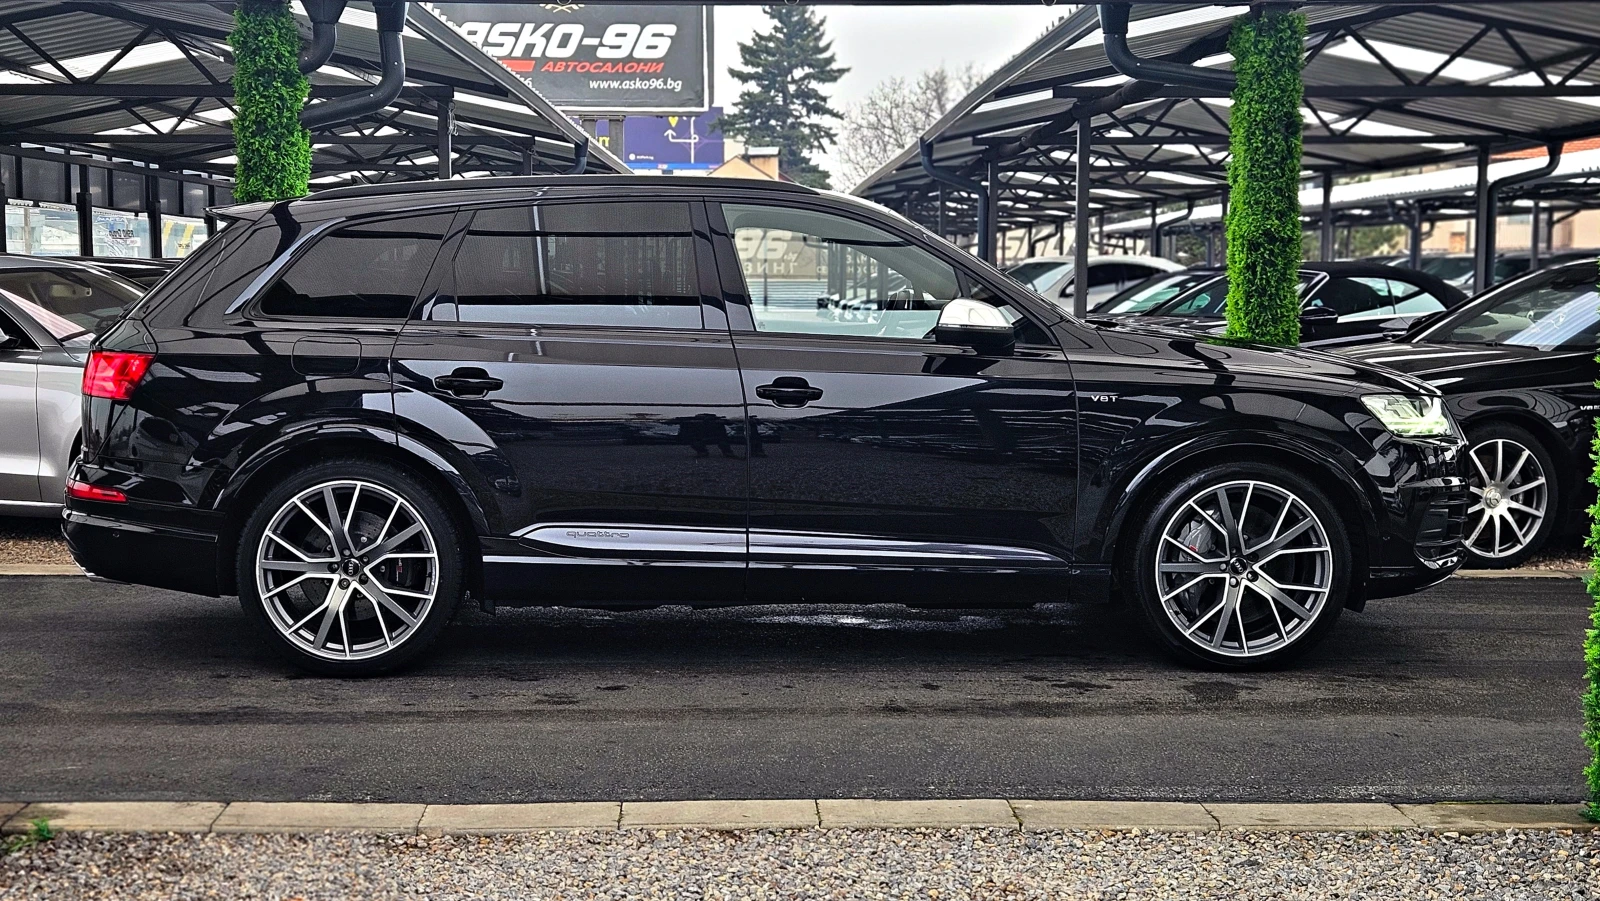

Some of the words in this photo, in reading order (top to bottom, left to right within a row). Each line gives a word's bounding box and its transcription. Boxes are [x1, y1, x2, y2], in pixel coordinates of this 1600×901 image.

[459, 21, 678, 59] ASKO-96
[541, 61, 665, 73] АВТОСАЛОНИ
[589, 77, 683, 92] www.asko96.bg
[565, 530, 630, 539] quattro
